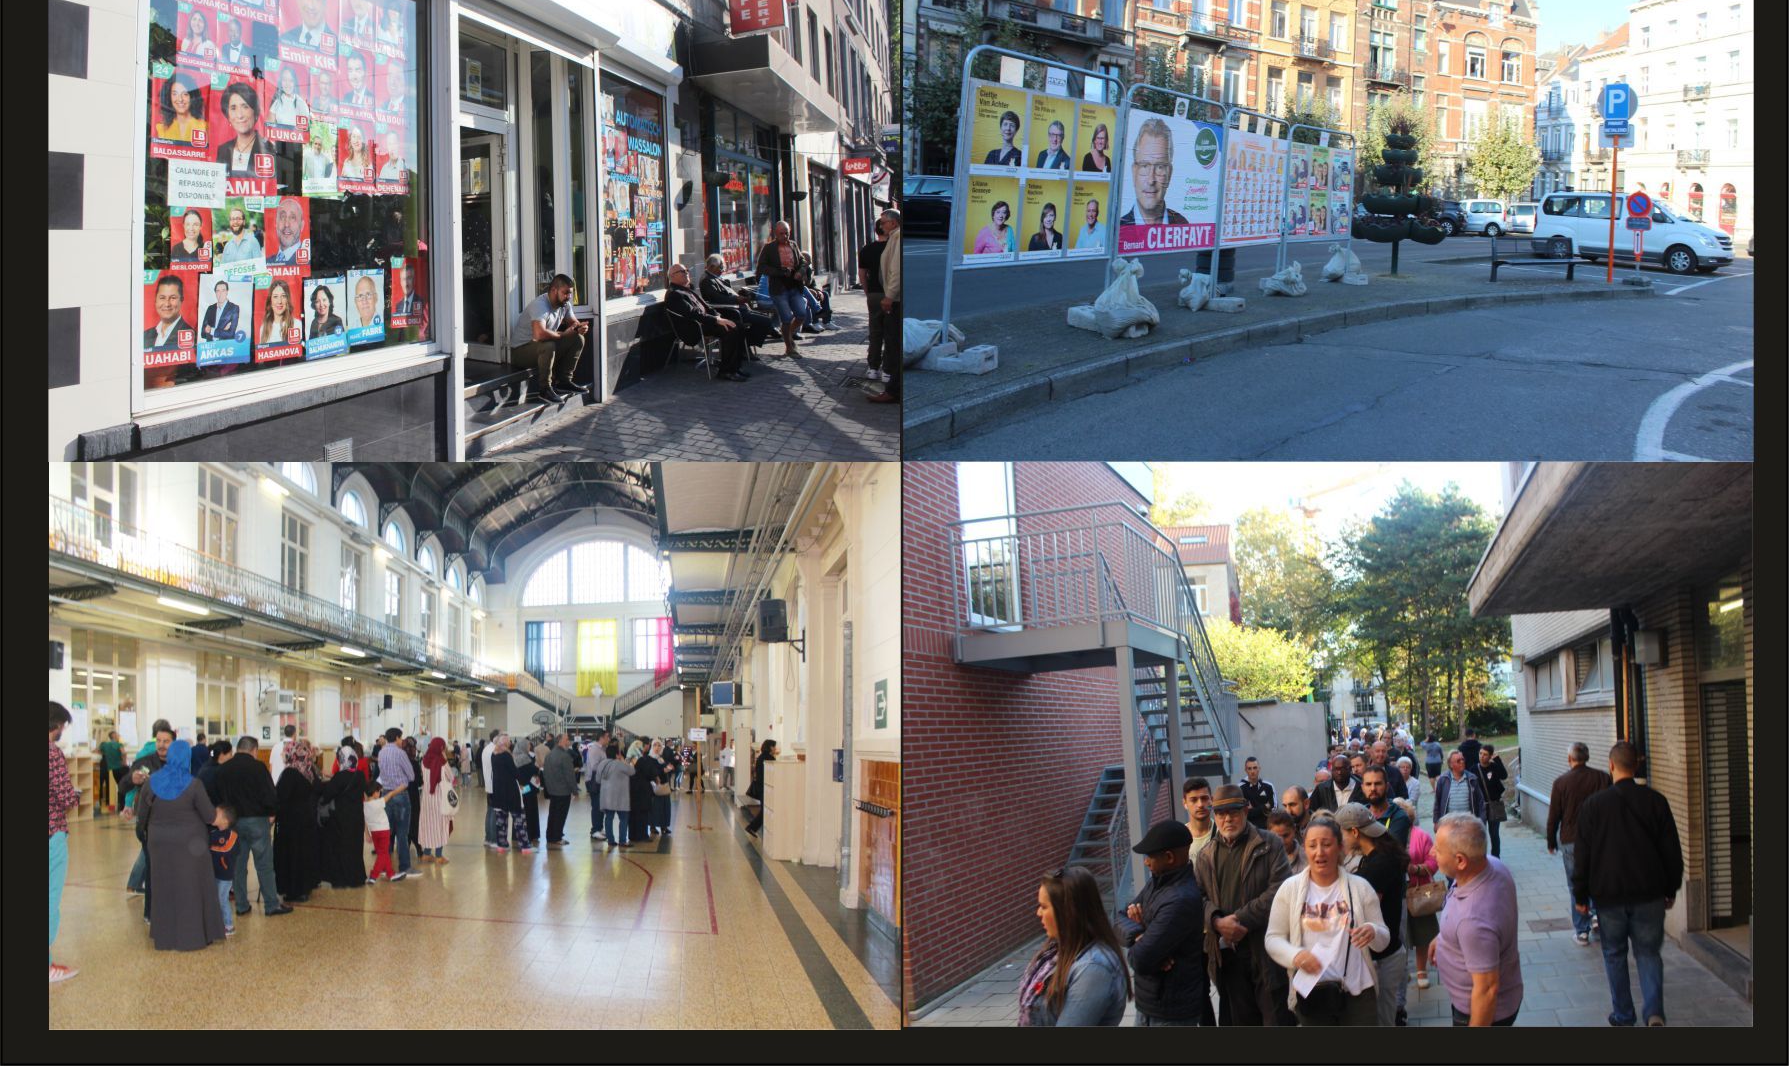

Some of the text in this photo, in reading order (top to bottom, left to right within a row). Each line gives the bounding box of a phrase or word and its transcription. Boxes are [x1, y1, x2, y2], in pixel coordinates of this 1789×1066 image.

[280, 45, 338, 71] Emir KIR
[155, 64, 169, 75] 24
[1608, 89, 1626, 114] P
[266, 128, 304, 142] ILUNGA
[153, 146, 206, 159] BALDASSARRE
[627, 136, 663, 156] WASSALON
[257, 155, 273, 170] LB
[226, 180, 267, 196] AMLI
[1147, 225, 1211, 249] CLERFAYT
[1123, 240, 1145, 250] Bernard
[362, 325, 383, 337] FABRE
[144, 350, 191, 366] UAHABI
[200, 347, 234, 360] AKKAS
[257, 346, 300, 360] HASANOVA
